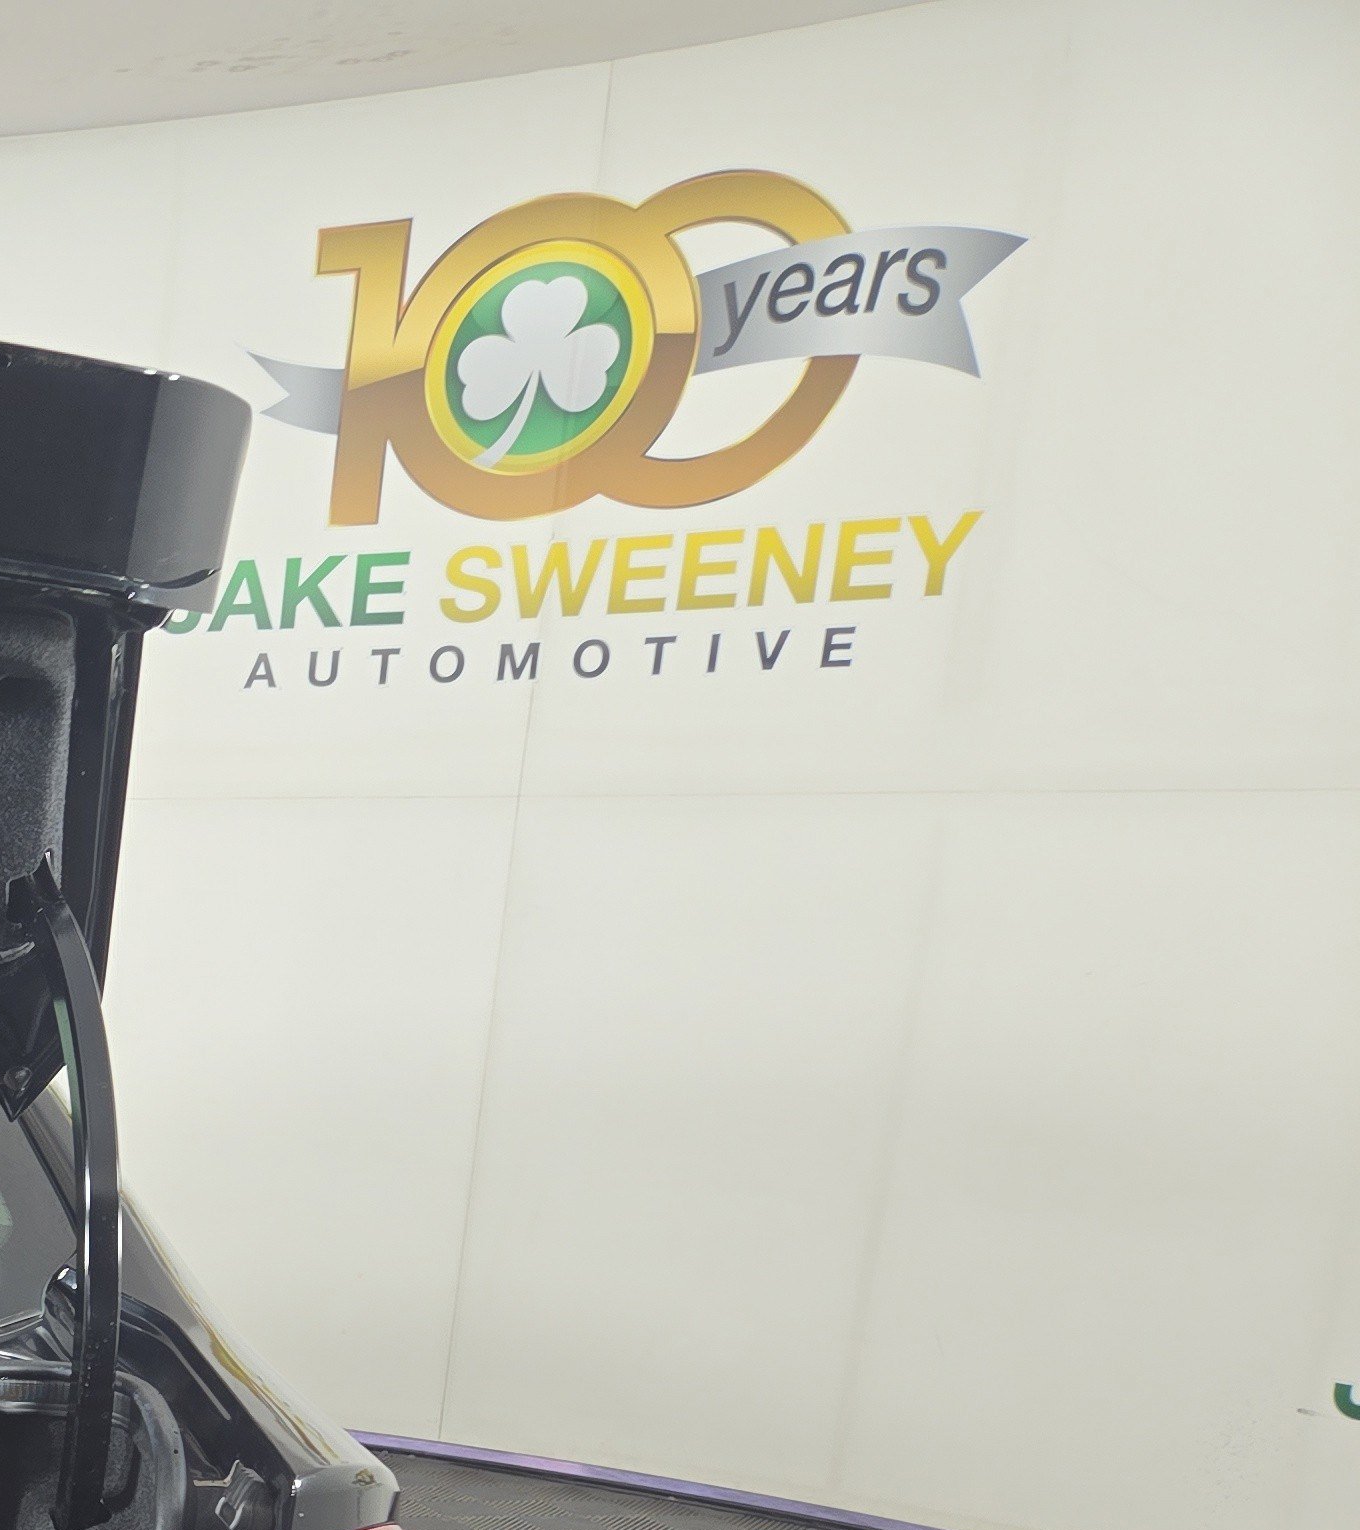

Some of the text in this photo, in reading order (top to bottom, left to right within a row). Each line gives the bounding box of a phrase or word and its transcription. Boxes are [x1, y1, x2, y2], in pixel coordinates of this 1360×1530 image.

[315, 169, 948, 528] 100 years
[439, 510, 985, 624] SWEENEY
[243, 626, 858, 690] AUTOMOTIVE
